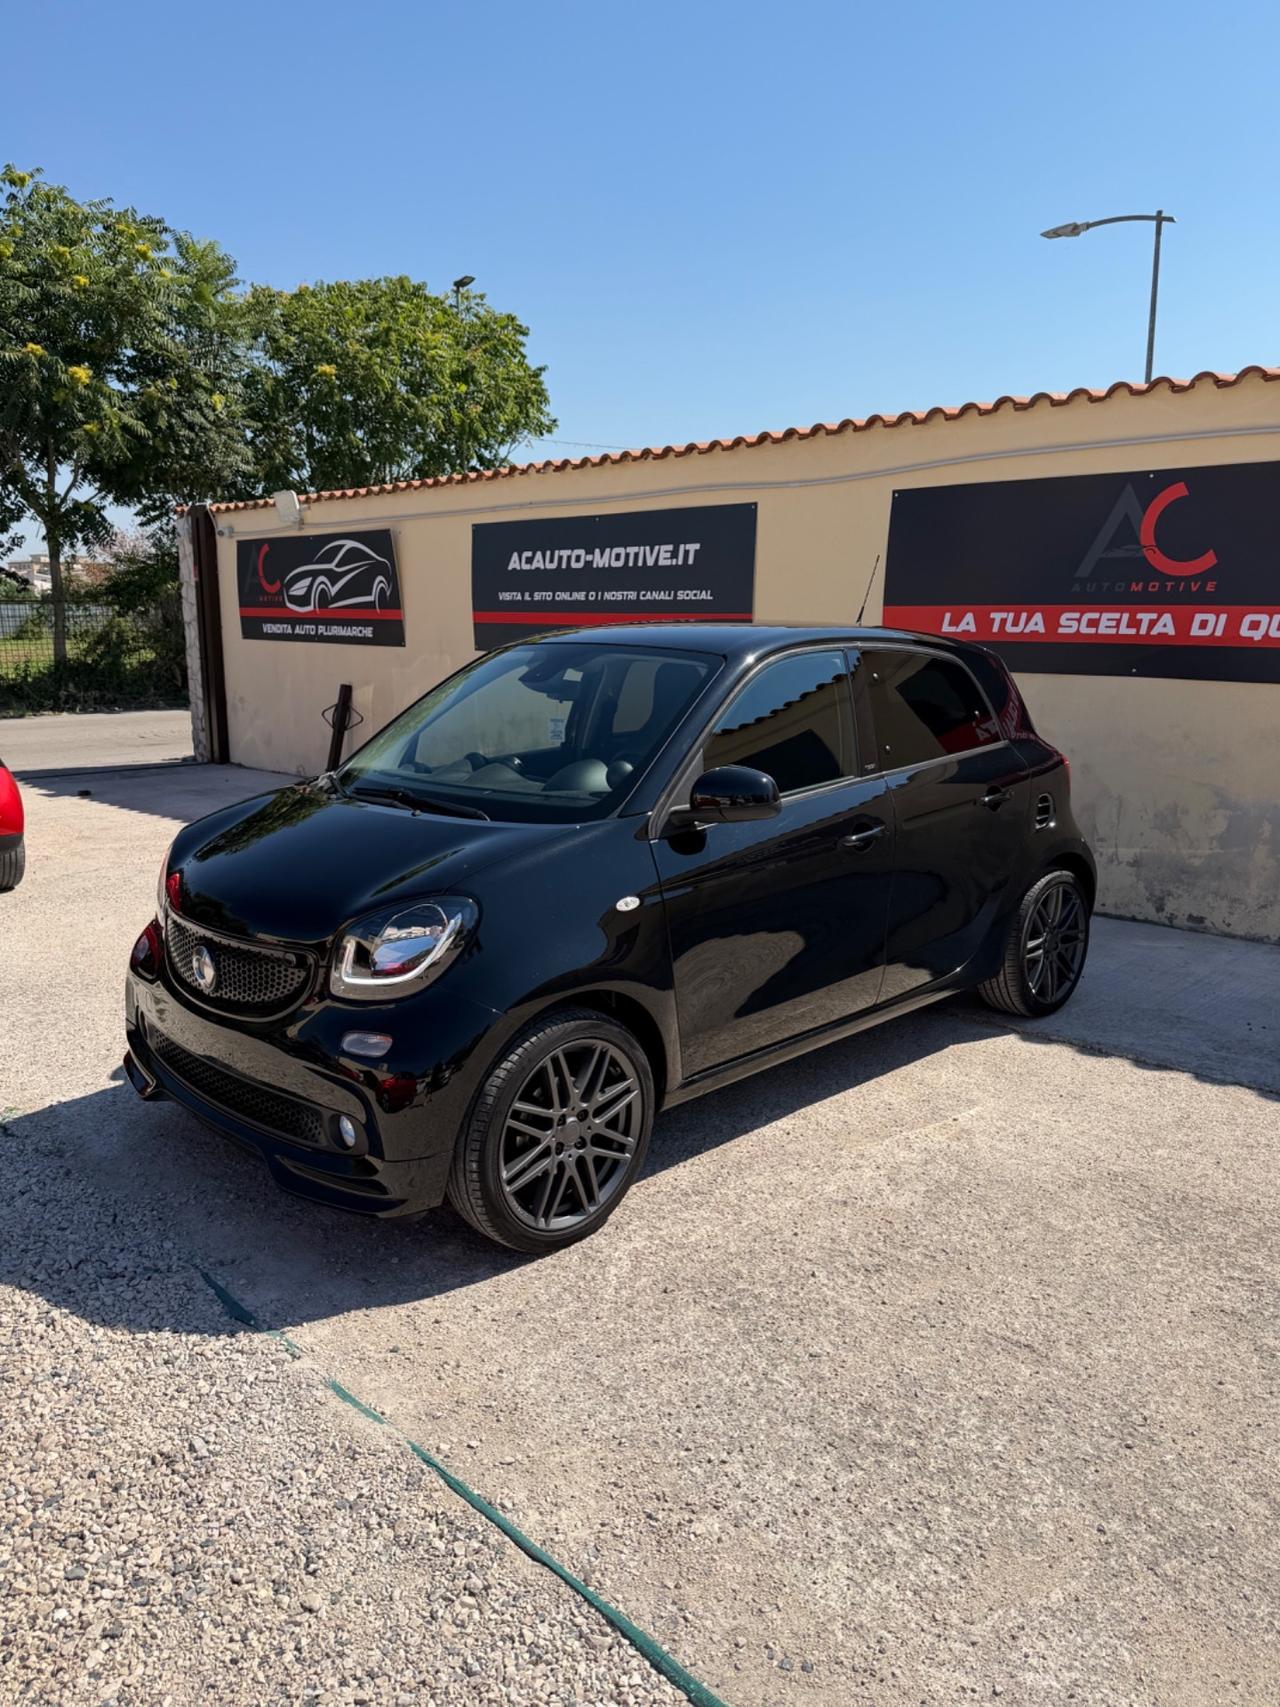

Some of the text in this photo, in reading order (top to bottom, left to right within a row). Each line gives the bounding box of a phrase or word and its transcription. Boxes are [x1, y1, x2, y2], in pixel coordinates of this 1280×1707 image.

[1074, 481, 1218, 577] AC
[507, 542, 701, 571] ACAUTO-MOTIVE.IT
[498, 591, 522, 601] VISITA
[524, 591, 532, 601] IL
[533, 591, 553, 601] SITO
[555, 591, 587, 601] ONLINE
[588, 591, 596, 601] O
[603, 591, 638, 601] NOSTRI
[639, 590, 674, 601] CANALI
[676, 589, 714, 600] SOCIAL
[1070, 580, 1218, 593] AUTOMOTIVE
[262, 623, 374, 638] VENDITA AUTO PLURIMARCHE
[941, 612, 977, 633] LA
[989, 612, 1046, 634] TUA
[1057, 612, 1176, 636] SCELTA
[1190, 613, 1228, 636] DI
